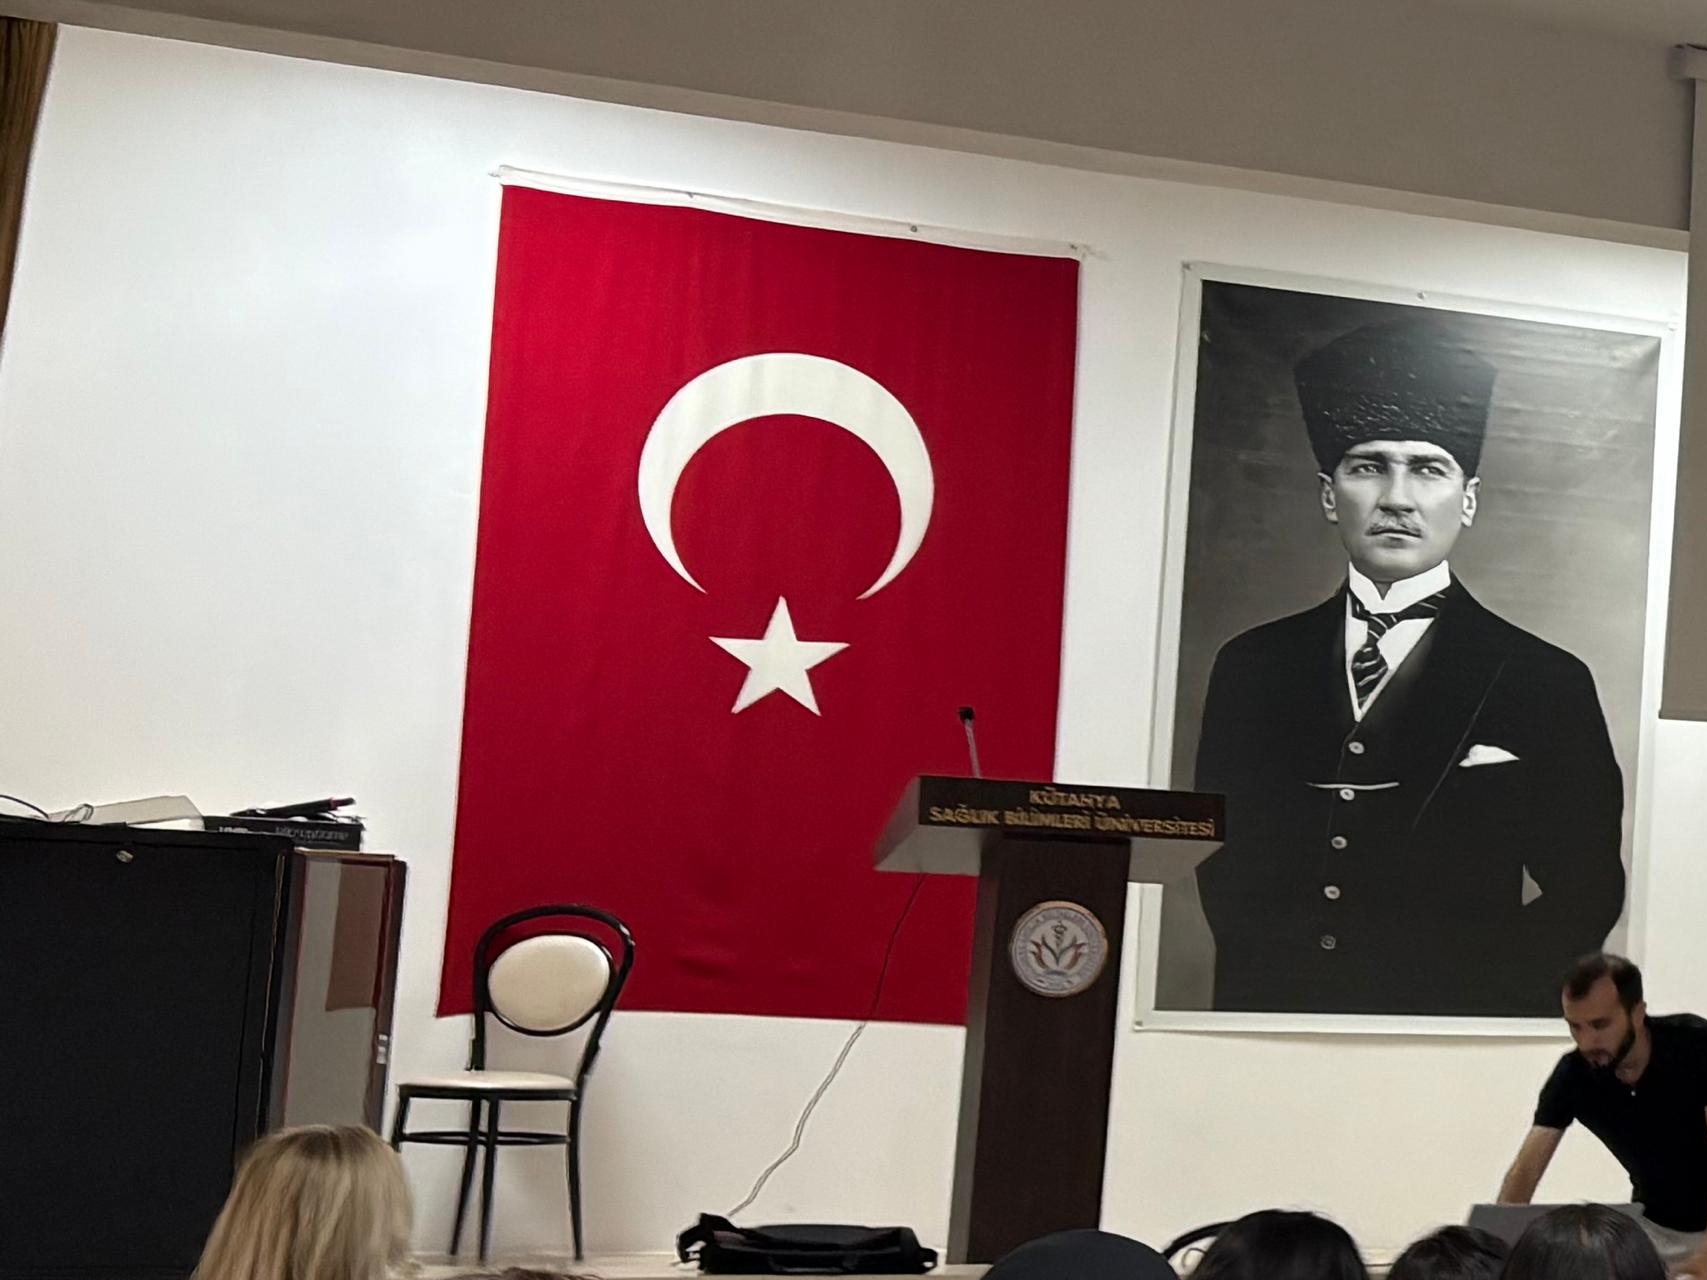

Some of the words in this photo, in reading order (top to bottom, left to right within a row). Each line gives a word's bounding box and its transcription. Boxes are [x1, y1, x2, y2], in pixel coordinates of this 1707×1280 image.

[1029, 786, 1121, 810] KÜTAHYA
[928, 804, 999, 825] SAĞLIK
[1004, 806, 1092, 830] BİLİMLERİ
[1095, 811, 1215, 837] ÜNİVERSİTESİ
